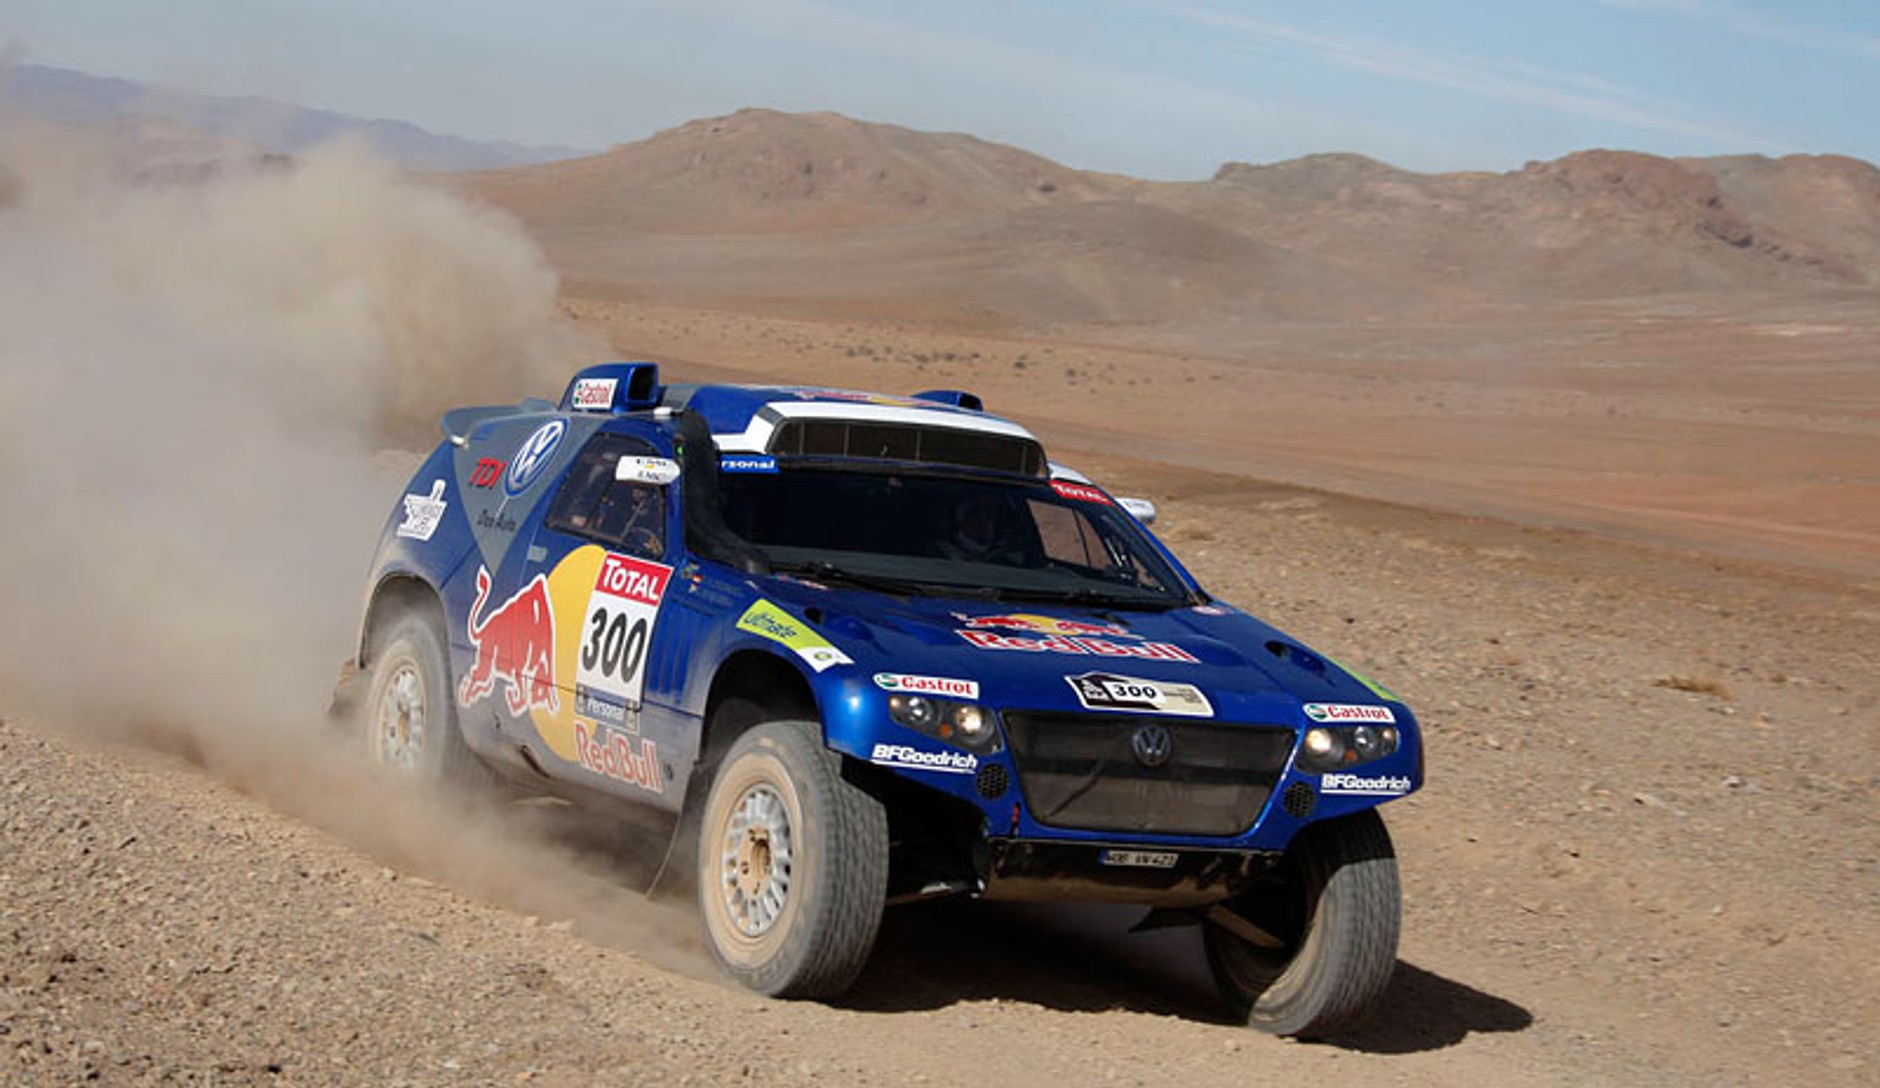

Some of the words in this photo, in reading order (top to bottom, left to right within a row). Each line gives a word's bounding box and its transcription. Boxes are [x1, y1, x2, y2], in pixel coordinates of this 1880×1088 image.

[469, 457, 509, 490] TDI
[721, 459, 775, 469] rsonal
[603, 558, 660, 598] TOTAL
[583, 607, 648, 683] 300
[955, 629, 1082, 655] Red
[1076, 634, 1201, 664] Bull
[900, 676, 973, 695] Castrol
[1112, 684, 1157, 699] 300
[1327, 704, 1391, 721] Castrol
[873, 744, 977, 769] BFGoodrich
[1321, 773, 1411, 791] BFGoodrich
